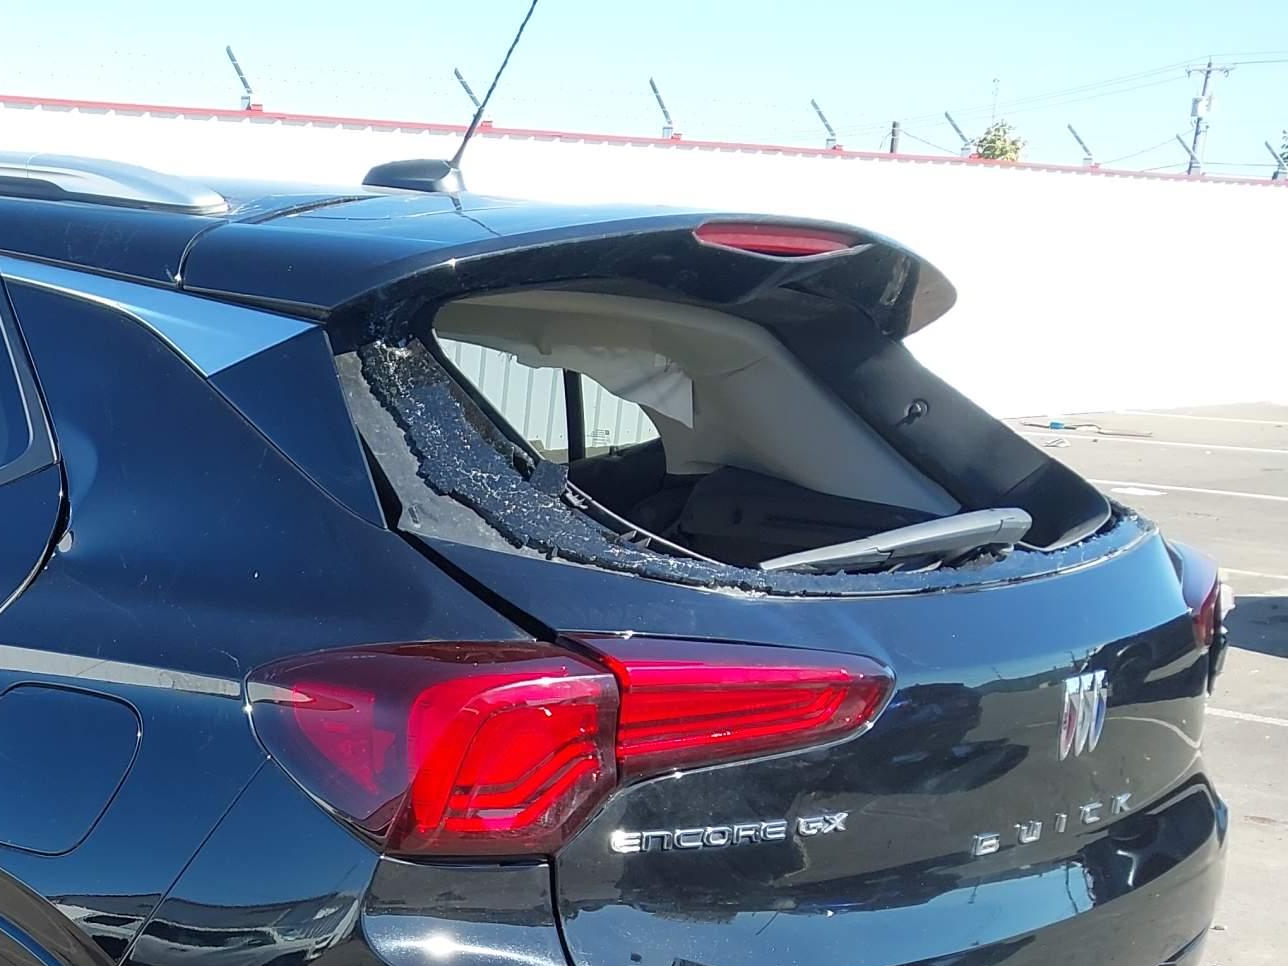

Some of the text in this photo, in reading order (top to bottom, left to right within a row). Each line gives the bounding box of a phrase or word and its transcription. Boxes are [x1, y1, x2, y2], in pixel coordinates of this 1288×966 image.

[611, 812, 849, 853] ENCORE GX
[972, 792, 1133, 857] BUICK
